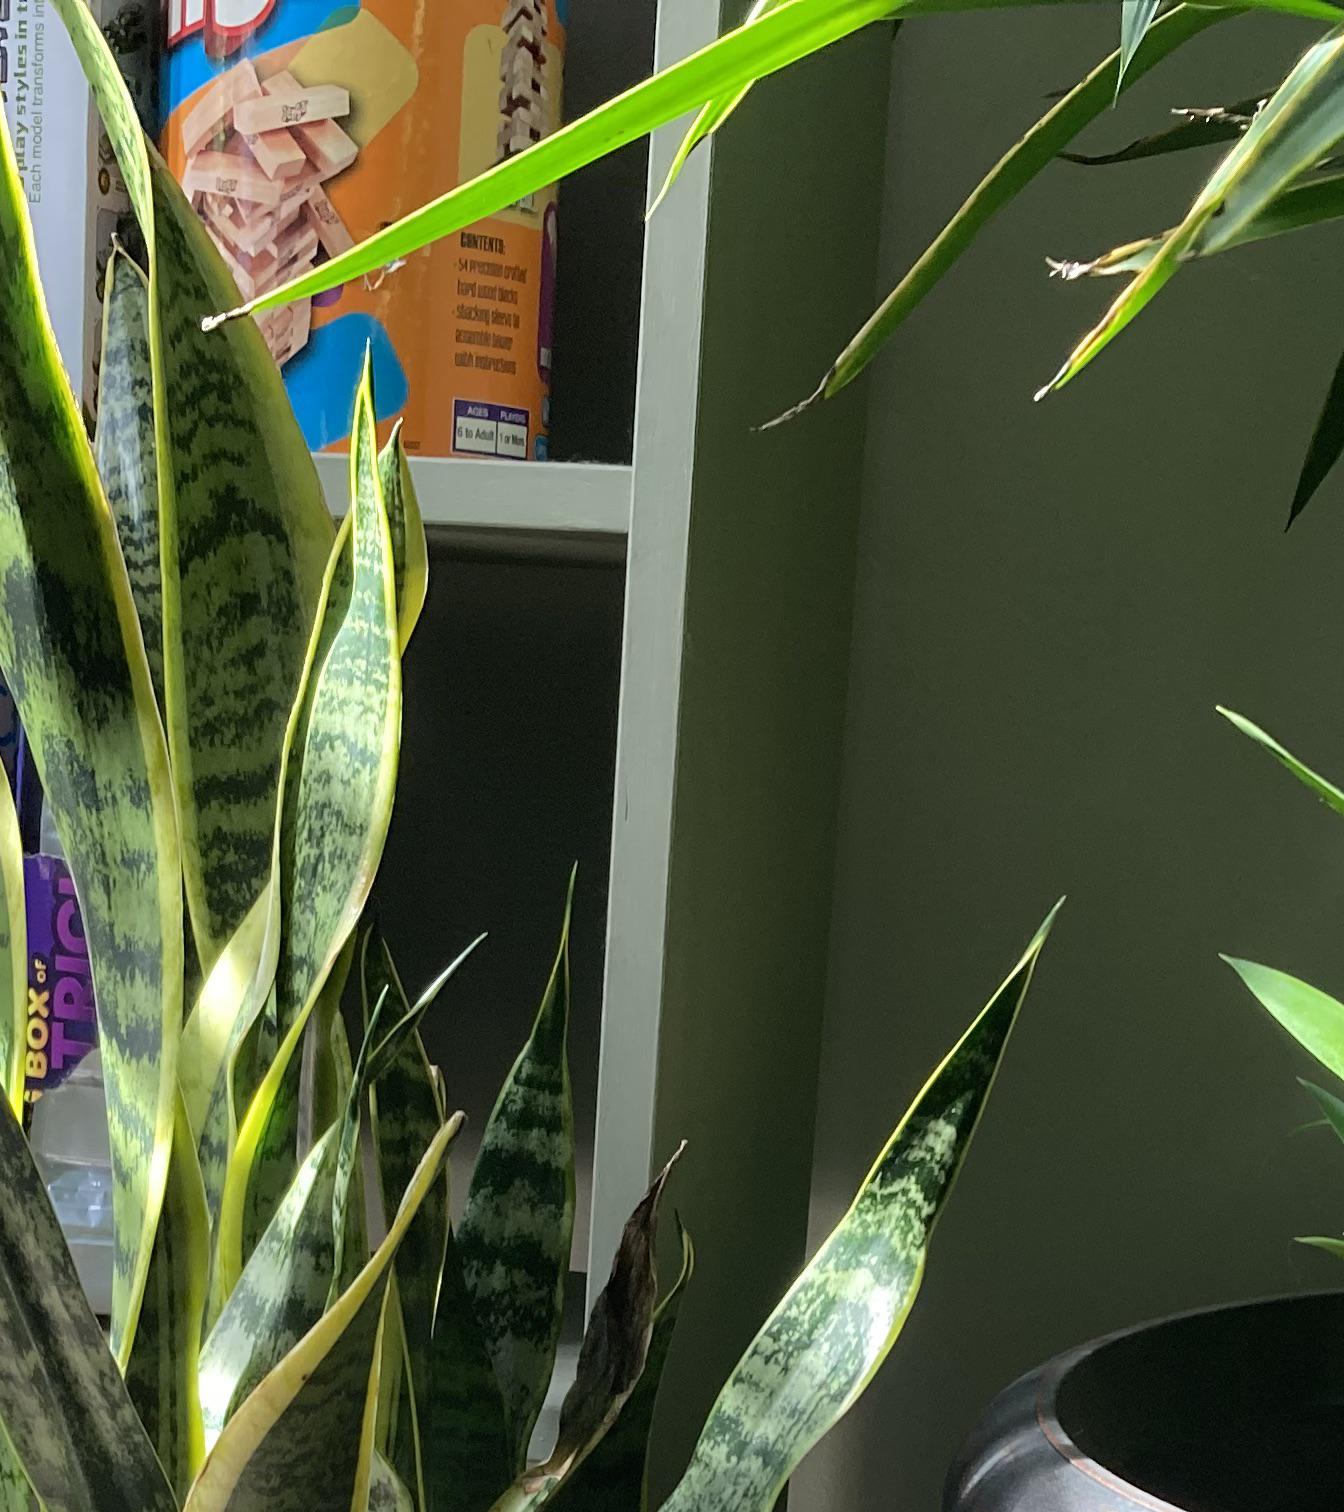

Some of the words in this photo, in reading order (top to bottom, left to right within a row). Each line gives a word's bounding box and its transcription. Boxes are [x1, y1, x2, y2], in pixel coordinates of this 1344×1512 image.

[15, 19, 27, 39] in
[14, 45, 30, 115] styles
[32, 22, 45, 106] transforms
[31, 112, 43, 160] model
[29, 164, 41, 203] Each
[467, 406, 489, 418] AGES
[457, 427, 463, 438] 6
[465, 428, 473, 439] to
[474, 429, 495, 442] Adult
[34, 958, 47, 984] OF
[51, 877, 100, 1070] TRIC
[25, 987, 50, 1079] BOX
